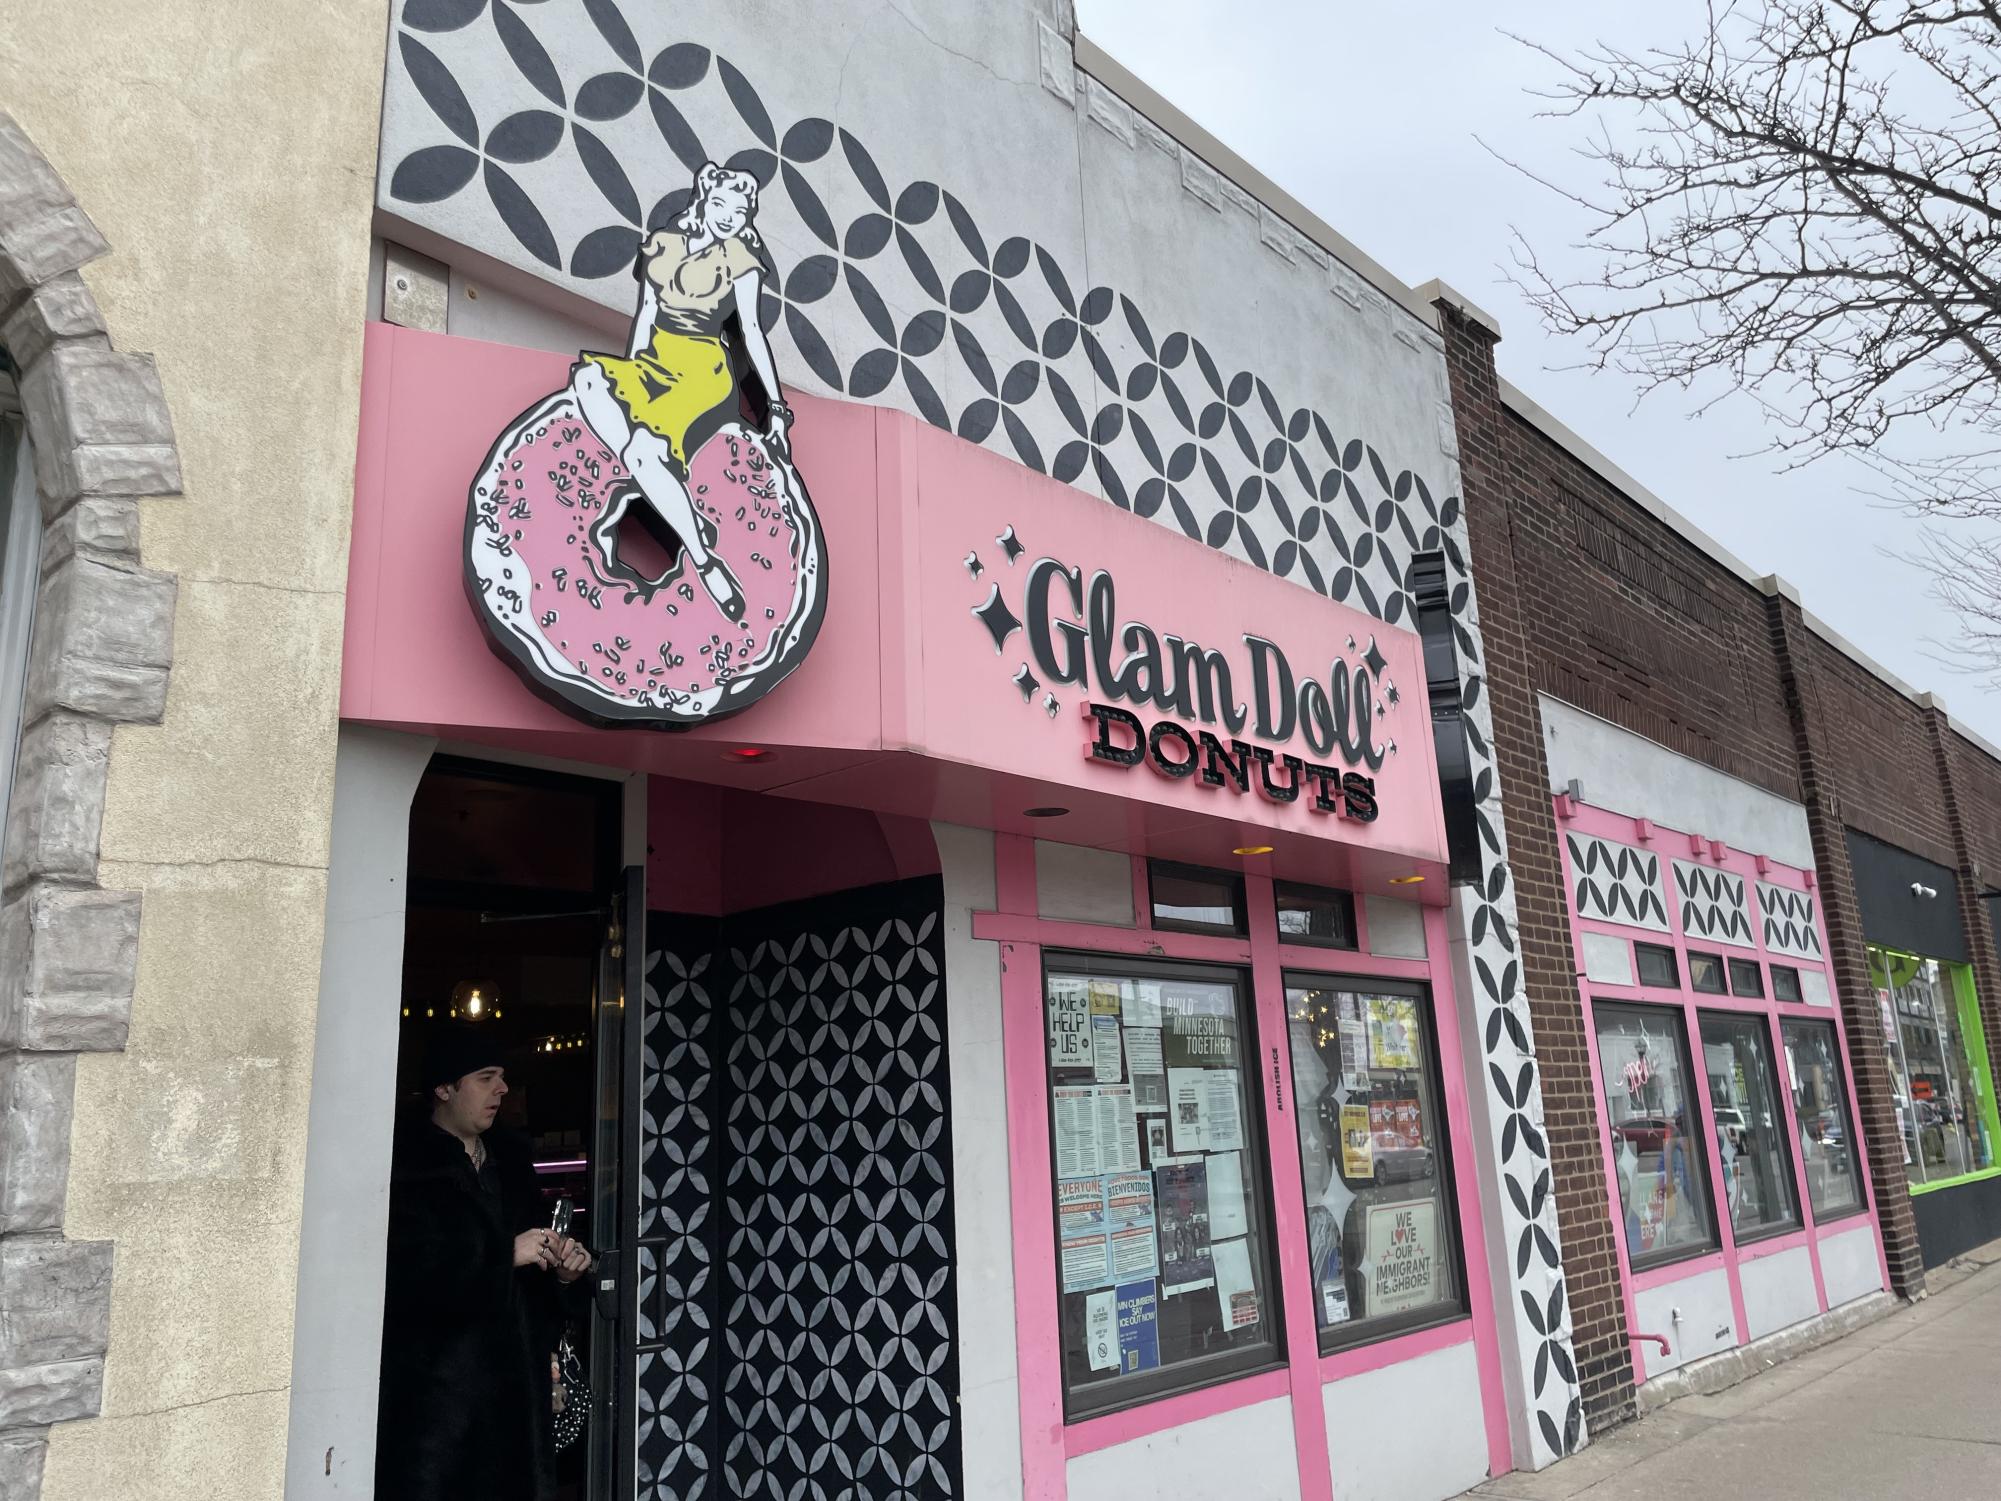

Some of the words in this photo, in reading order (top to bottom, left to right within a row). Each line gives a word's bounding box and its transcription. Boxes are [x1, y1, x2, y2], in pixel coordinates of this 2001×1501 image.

[1024, 557, 1247, 734] Glam
[1242, 633, 1385, 772] Doll
[1080, 700, 1378, 825] DONUTS
[1059, 991, 1077, 1011] WE
[1166, 997, 1194, 1016] BUILD
[1053, 1012, 1085, 1032] HELP
[1173, 1017, 1225, 1035] MINNESOTA
[1061, 1034, 1077, 1054] US
[1186, 1036, 1231, 1055] TOGETHER
[1058, 1180, 1102, 1197] EVERYONE
[1108, 1182, 1150, 1197] BIENVENIDOS
[1064, 1194, 1089, 1203] WELCOME
[1396, 1212, 1412, 1228] WE
[1395, 1246, 1413, 1260] OUR
[1376, 1256, 1431, 1281] IMMIGRANT
[1128, 1294, 1155, 1309] CLIMBERS
[1131, 1306, 1143, 1316] SAY
[1120, 1317, 1129, 1328] ICE
[1129, 1315, 1141, 1325] OUT
